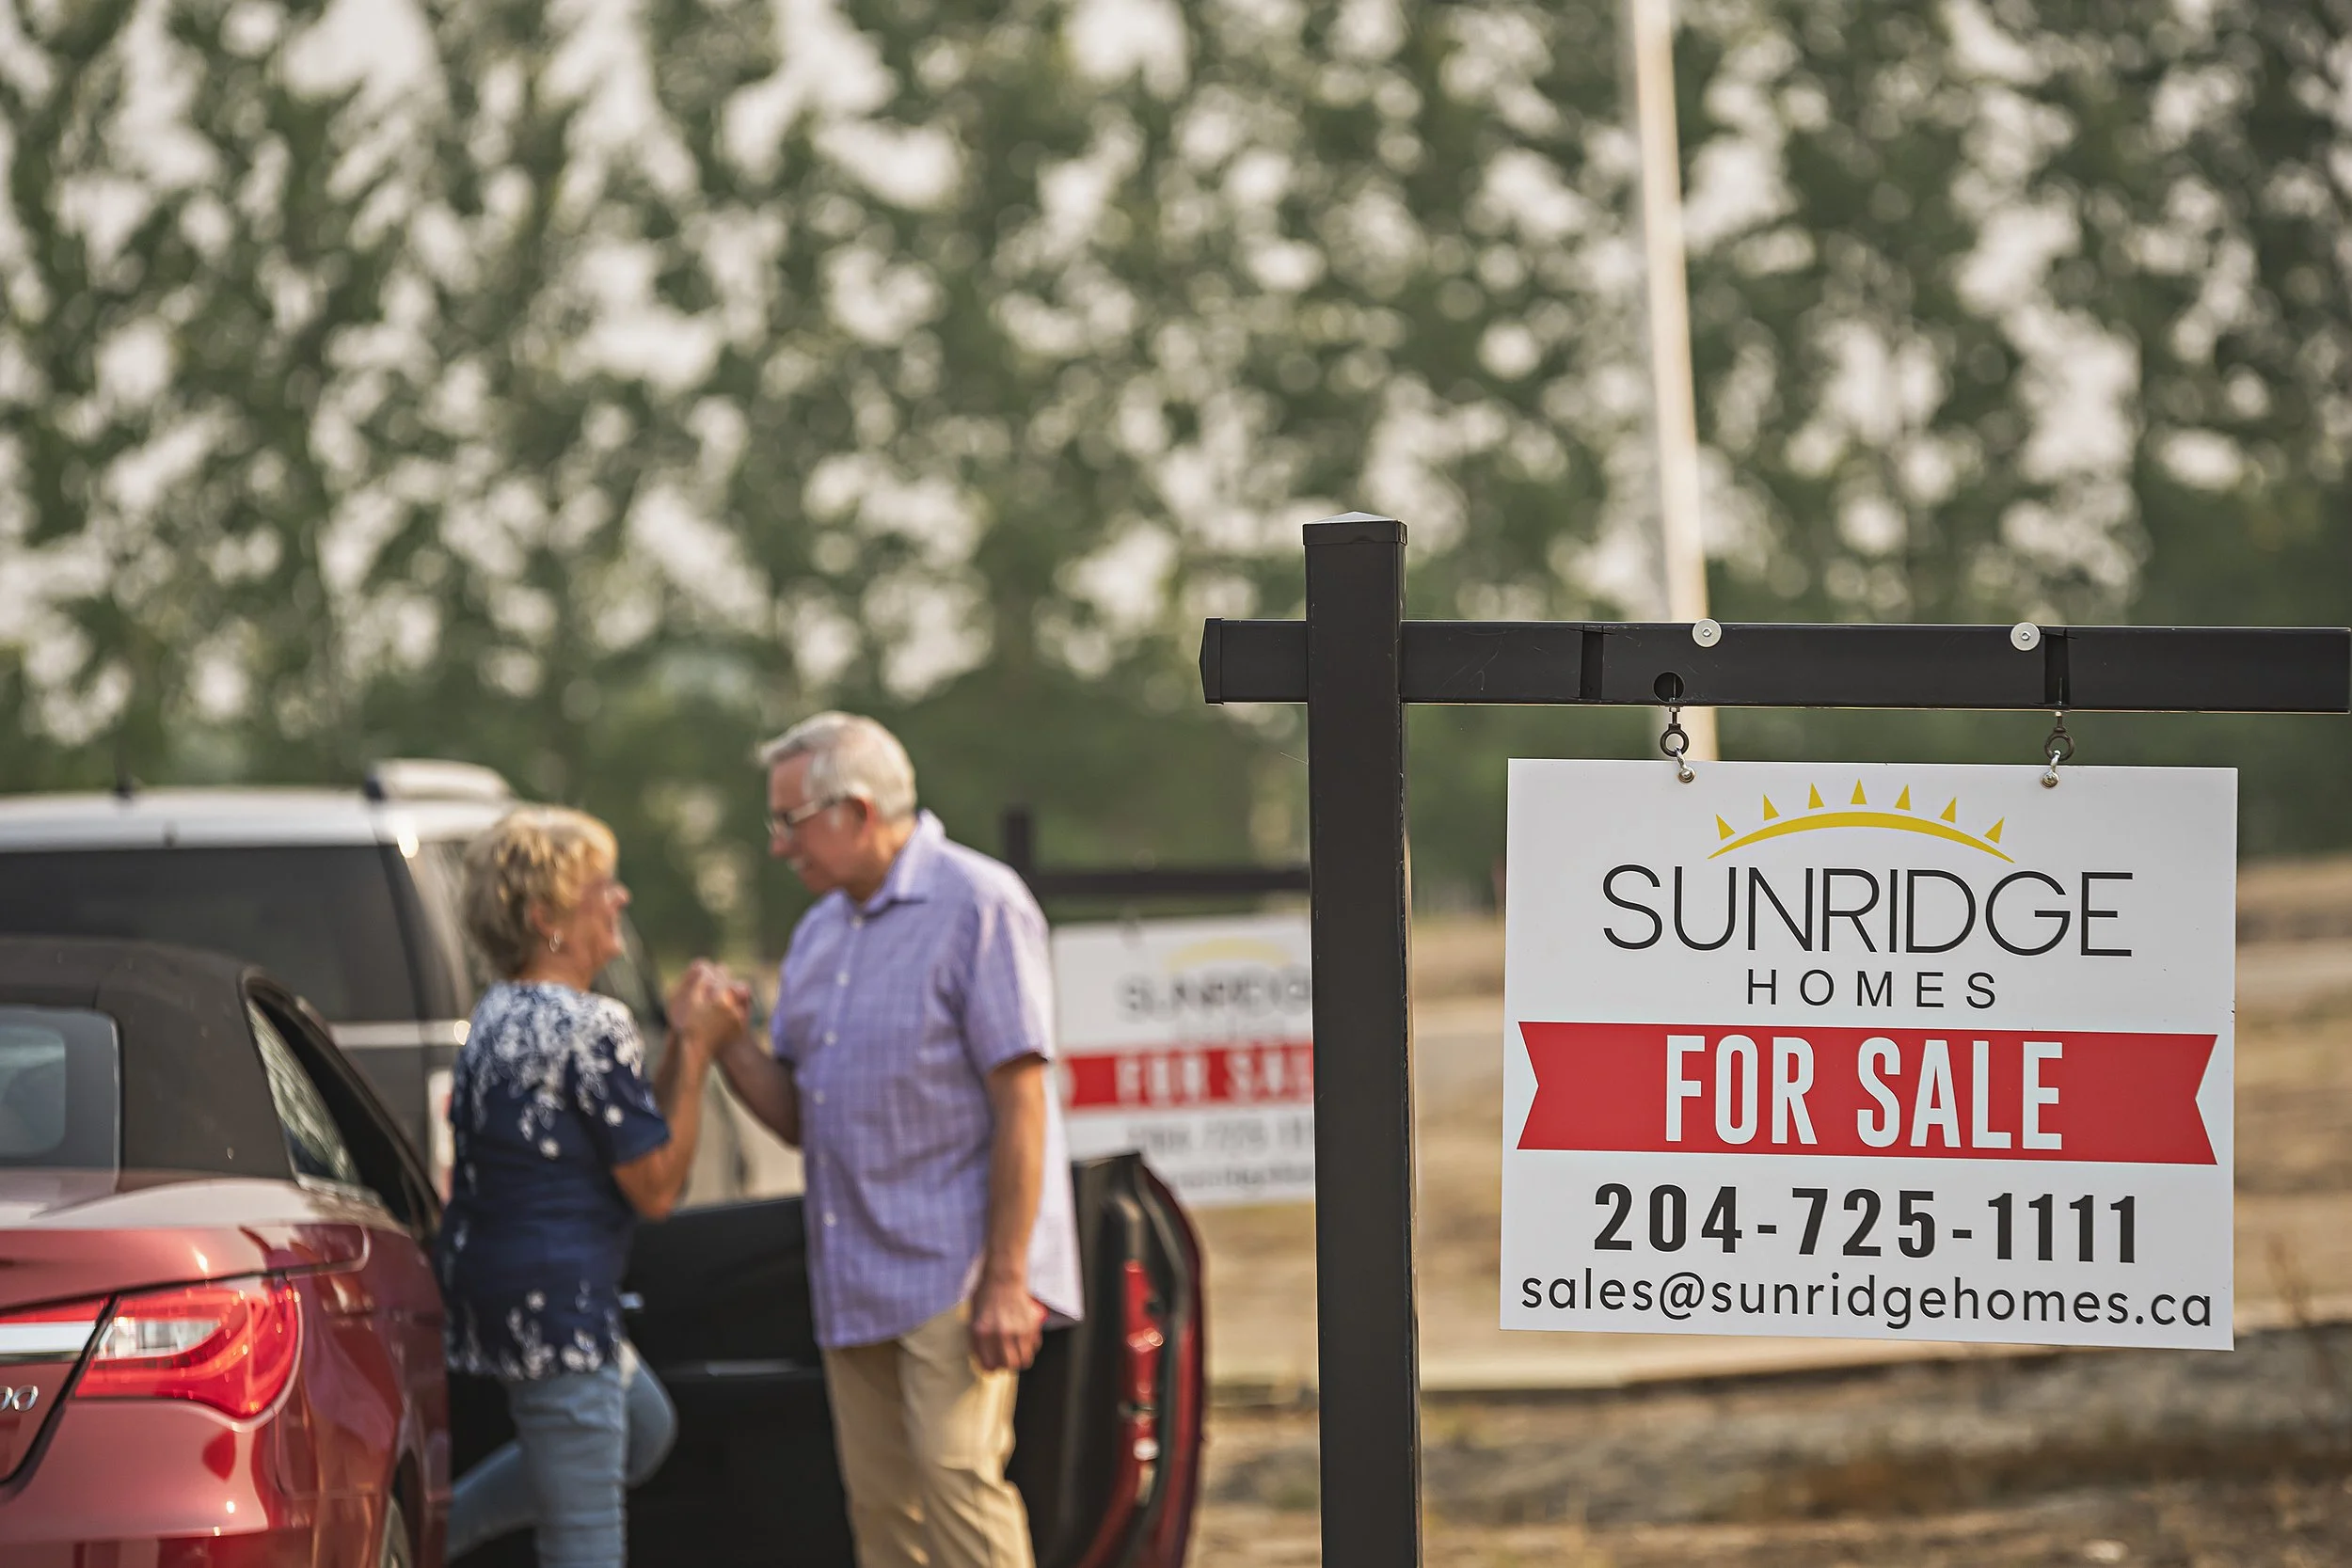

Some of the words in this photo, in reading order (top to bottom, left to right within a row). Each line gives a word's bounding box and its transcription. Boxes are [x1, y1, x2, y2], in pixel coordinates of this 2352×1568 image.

[1602, 863, 2136, 959] SUNRIDGE
[1746, 968, 1997, 1011] HOMES
[1664, 1034, 1820, 1146] FOR
[1856, 1037, 2064, 1151] SALE
[1594, 1182, 2137, 1265] 204-725-1111
[1521, 1267, 2213, 1332] sales@sunridgehomes.ca
